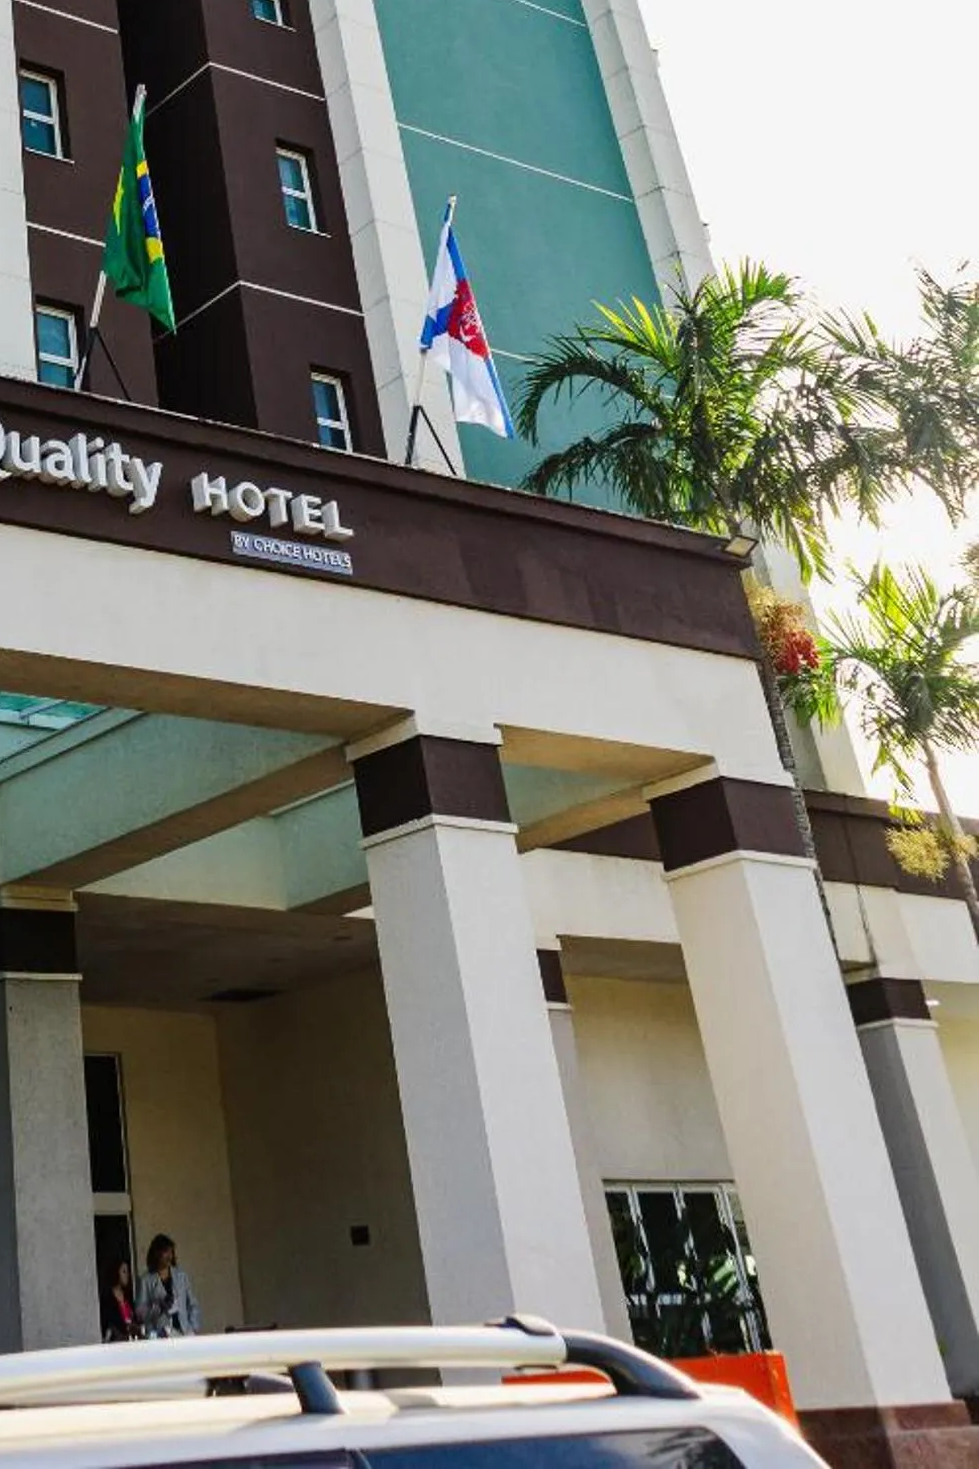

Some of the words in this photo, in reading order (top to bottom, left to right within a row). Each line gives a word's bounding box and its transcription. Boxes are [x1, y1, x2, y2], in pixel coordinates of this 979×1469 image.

[192, 472, 355, 541] HOTEL
[233, 535, 250, 550] BY
[253, 539, 301, 559] CHOICE
[303, 547, 352, 568] HOTELS
